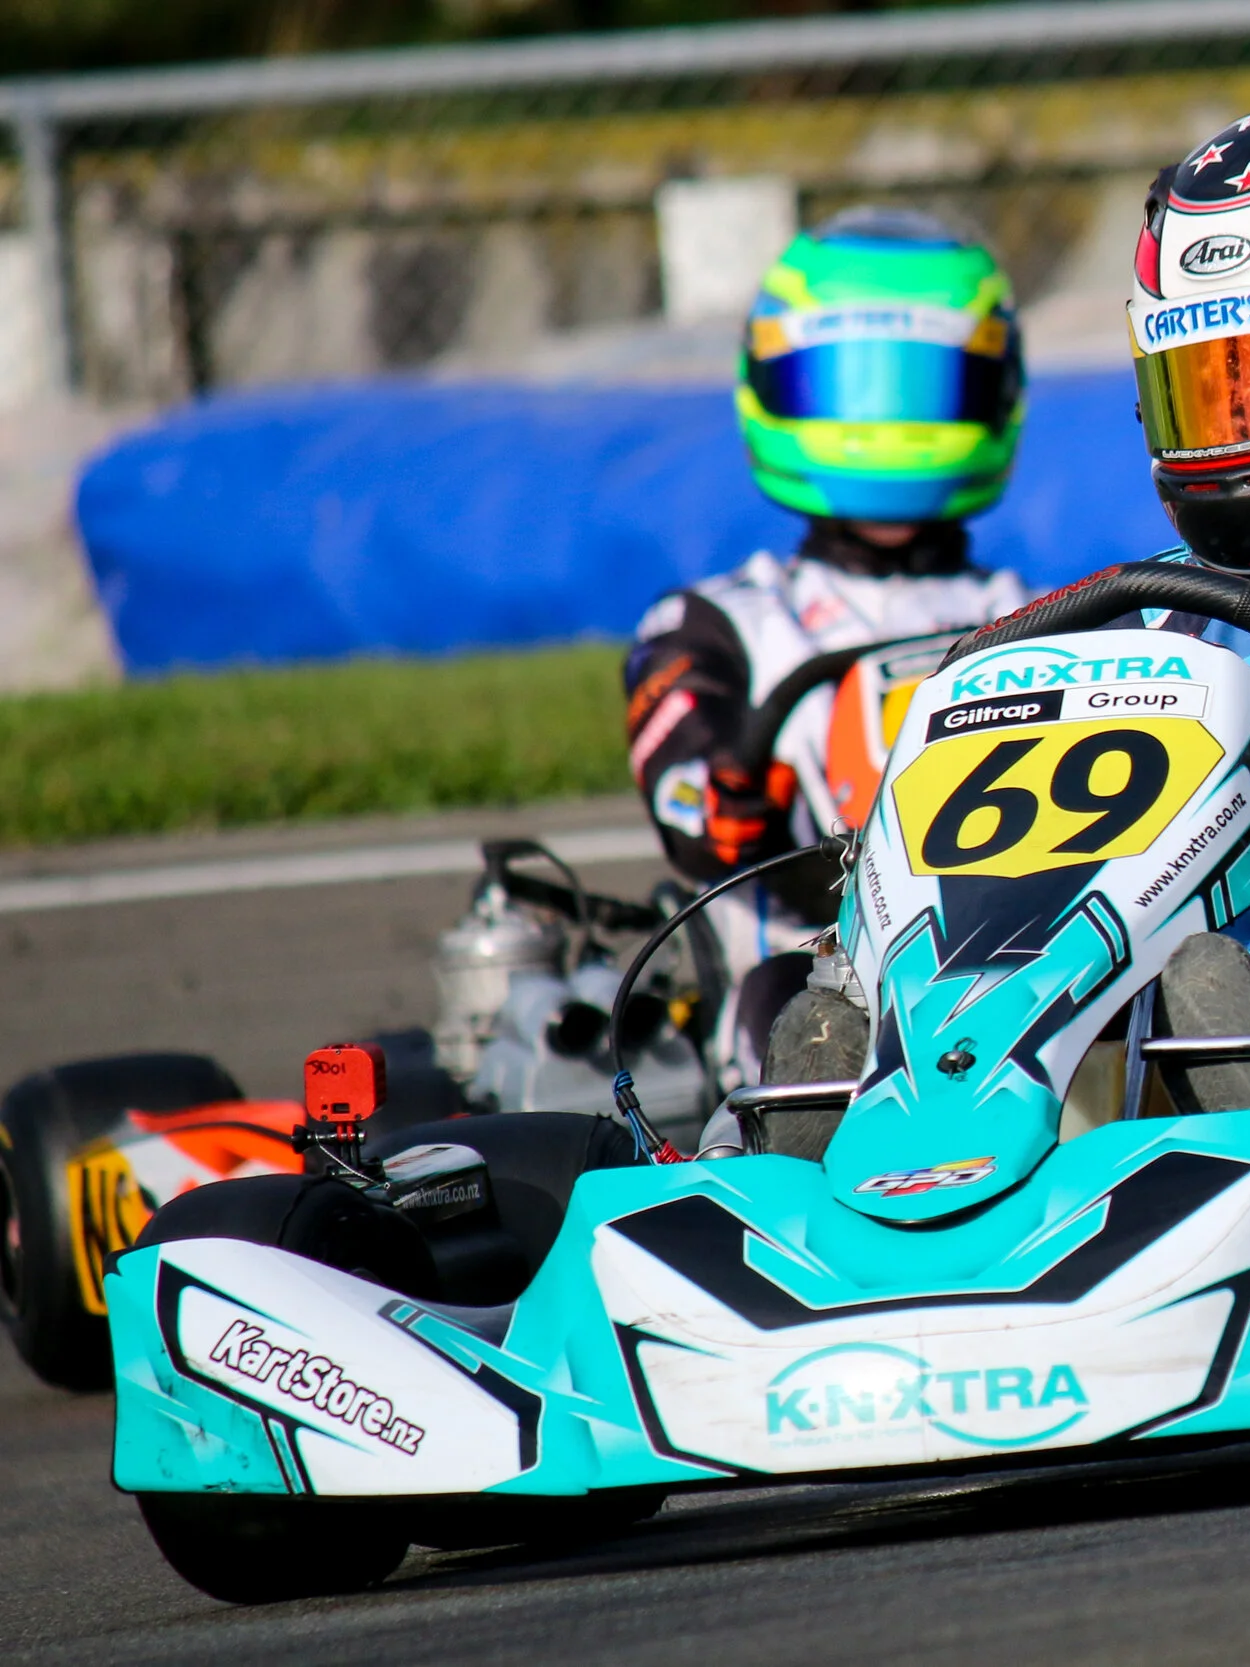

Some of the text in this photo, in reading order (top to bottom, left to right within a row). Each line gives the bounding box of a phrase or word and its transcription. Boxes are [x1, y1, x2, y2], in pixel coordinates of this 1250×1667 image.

[1187, 238, 1247, 270] Arai
[943, 691, 1178, 730] Giltrap Group
[921, 729, 1170, 869] 69
[1134, 793, 1247, 908] www.knxtra.co.nz
[210, 1319, 426, 1456] KartStore.nz
